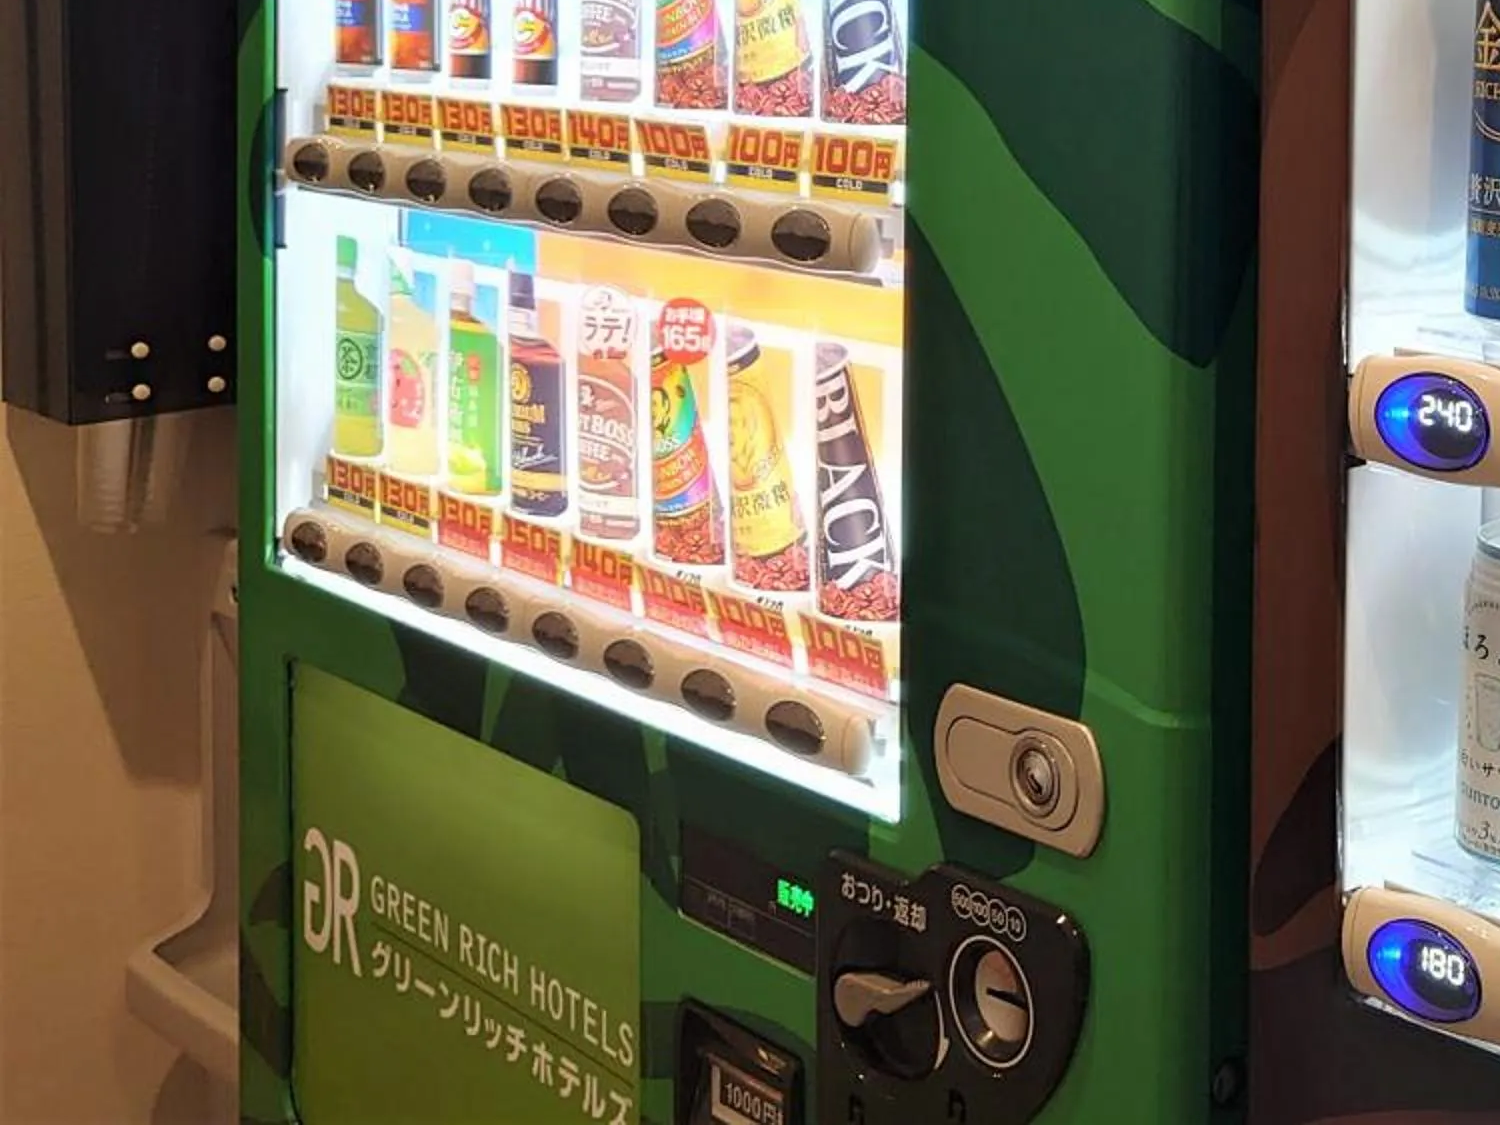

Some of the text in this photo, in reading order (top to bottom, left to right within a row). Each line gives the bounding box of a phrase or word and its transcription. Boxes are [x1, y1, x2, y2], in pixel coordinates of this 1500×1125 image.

[814, 134, 895, 179] 100円
[1418, 395, 1472, 432] 240
[370, 875, 634, 1068] GREEN RICH HOTELS
[1421, 946, 1465, 986] 180
